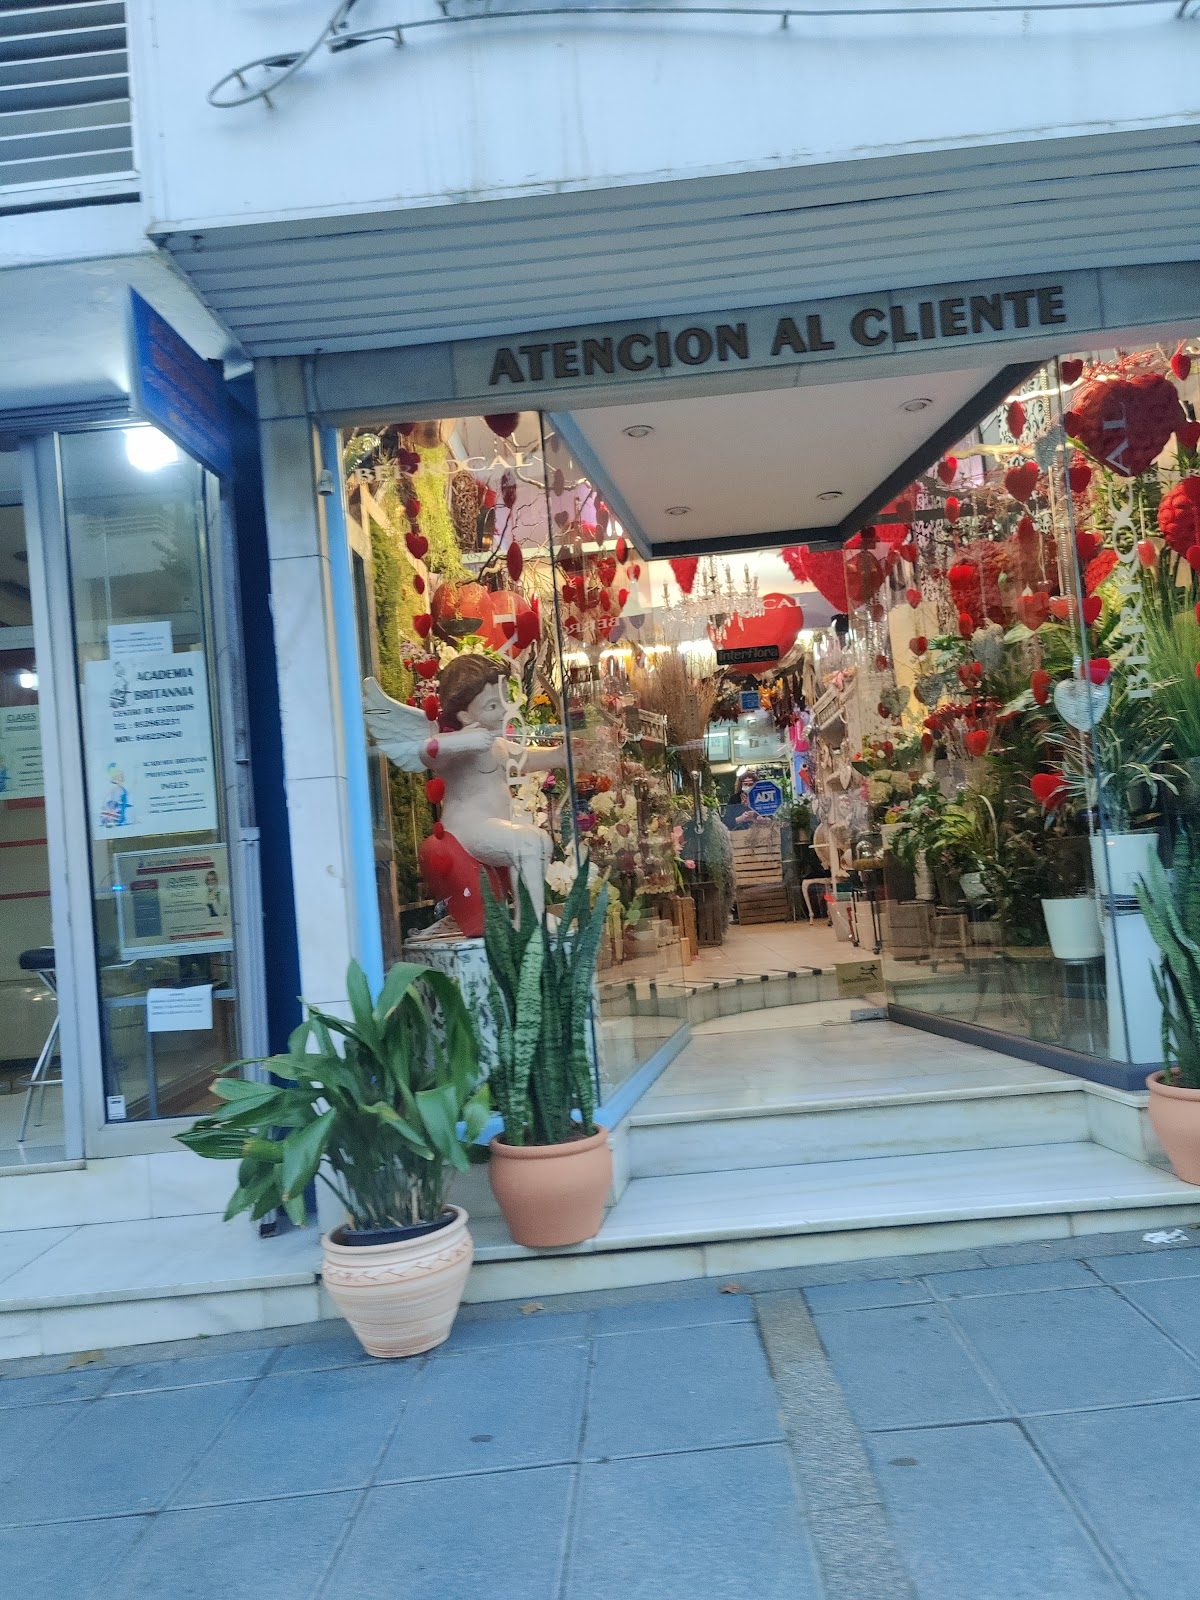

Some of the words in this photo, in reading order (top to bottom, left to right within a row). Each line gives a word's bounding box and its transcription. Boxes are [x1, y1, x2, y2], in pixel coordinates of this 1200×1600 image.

[488, 322, 749, 386] ATENCION
[770, 313, 836, 357] AL
[849, 285, 1068, 347] CLIENTE
[353, 451, 534, 484] BEROCAL
[136, 667, 194, 681] ACADEMIA
[134, 686, 194, 700] BRITANNIA
[755, 790, 777, 803] ADT
